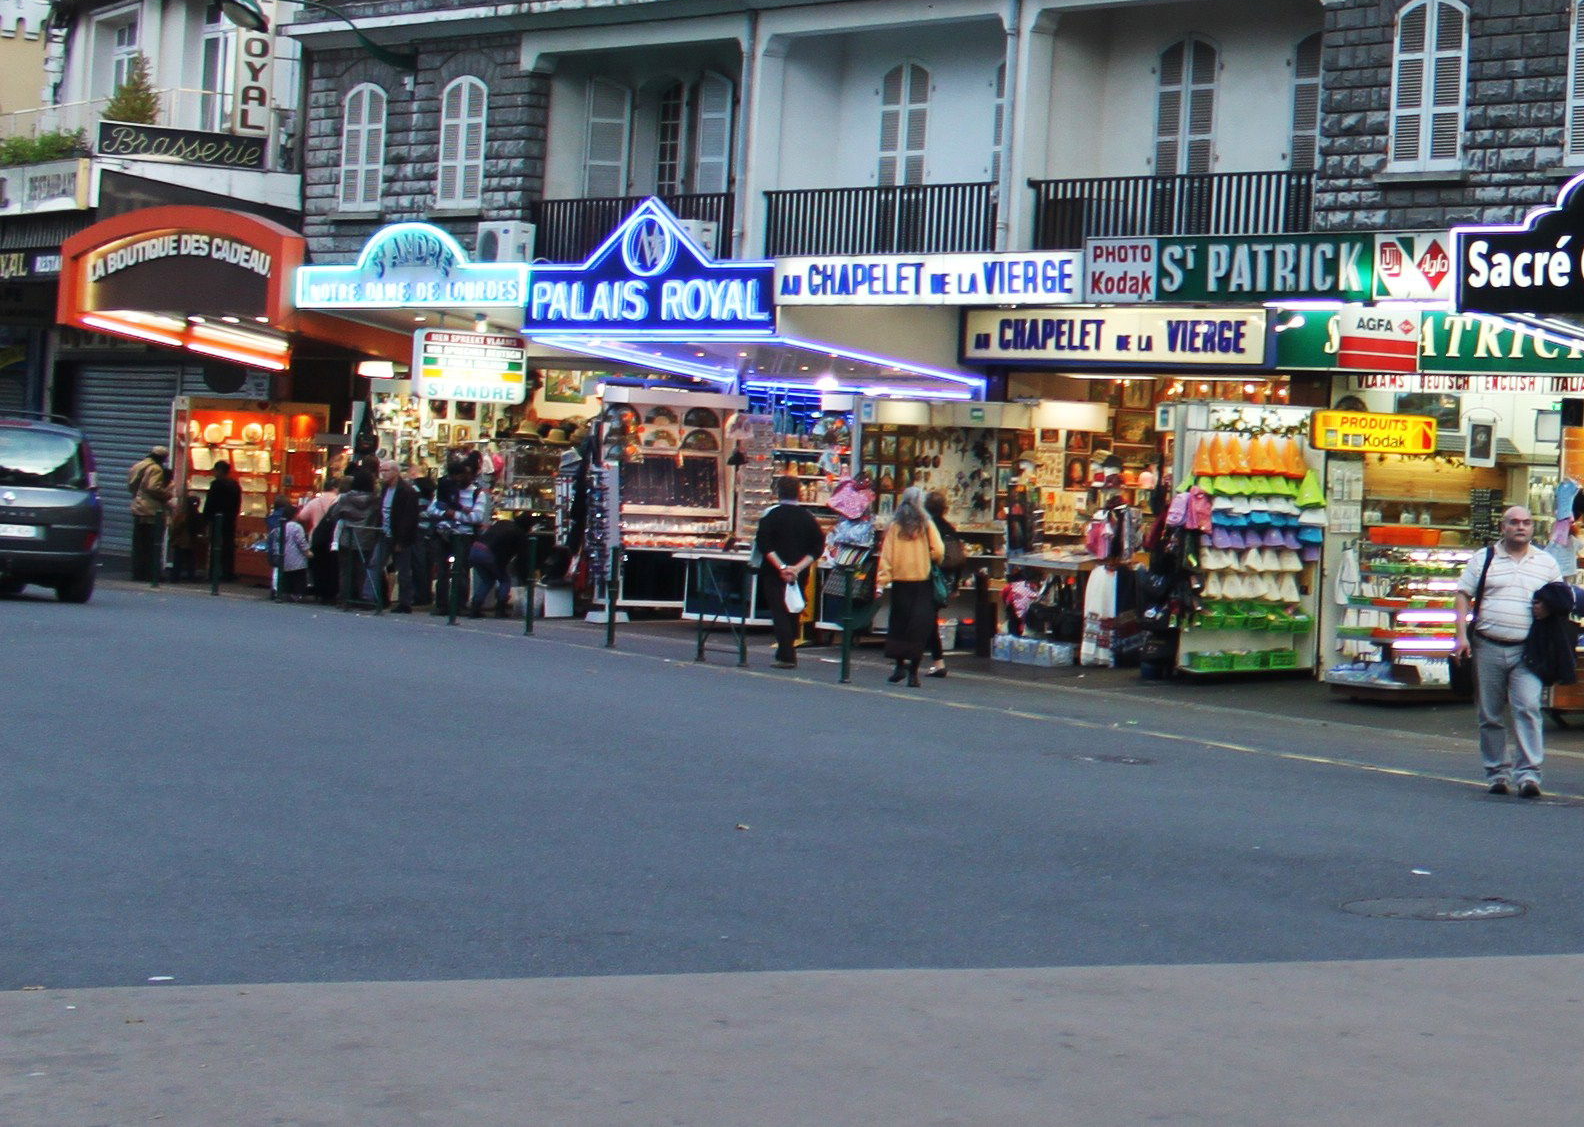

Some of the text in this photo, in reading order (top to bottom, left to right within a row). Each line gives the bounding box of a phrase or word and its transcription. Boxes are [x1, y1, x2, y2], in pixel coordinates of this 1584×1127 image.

[240, 27, 270, 130] OYAL
[102, 127, 261, 165] Brasserie
[88, 234, 271, 282] LA BOUTIQUE DES CADEAU
[1093, 244, 1151, 263] PHOTO
[1207, 241, 1364, 291] PATRICK
[1421, 254, 1448, 277] Agfa
[1468, 236, 1570, 288] Sacré
[310, 280, 518, 301] NOTRE DAME DE LOURDES
[781, 259, 1073, 295] AU CHAPELET DE LA VIERGE
[1091, 271, 1151, 295] Kodak
[532, 279, 770, 320] PALAIS ROYAL
[998, 319, 1105, 351] CHAPELET
[1116, 334, 1130, 351] DE
[1138, 334, 1152, 351] LA
[1167, 320, 1247, 353] VIERGE
[1324, 316, 1340, 353] S
[1357, 316, 1393, 333] AGFA
[453, 385, 515, 400] ANDRE
[1357, 375, 1404, 389] VLAAMS
[1419, 376, 1469, 390] DEUTSCH
[1485, 376, 1536, 390] ENGLISH
[1340, 417, 1408, 431] PRODUITS
[1363, 433, 1405, 449] Kodak
